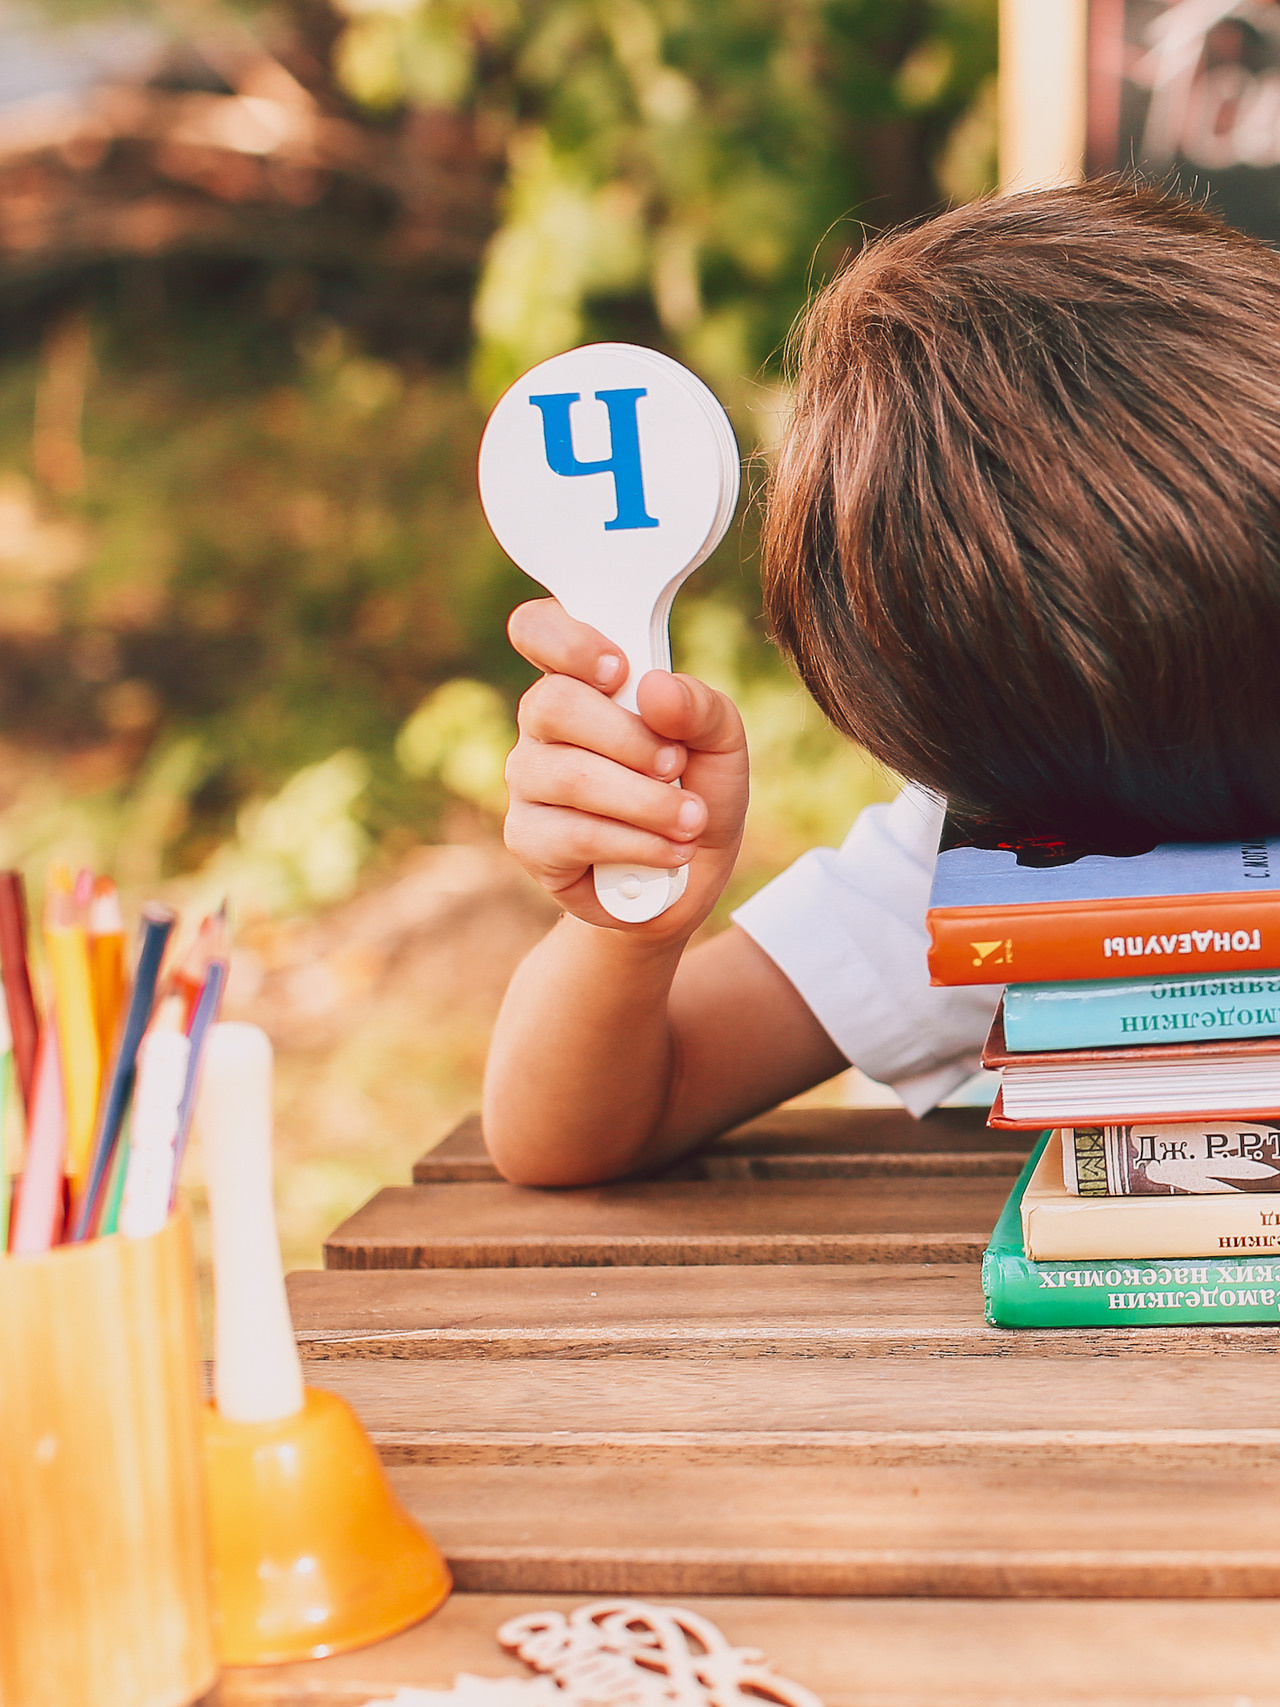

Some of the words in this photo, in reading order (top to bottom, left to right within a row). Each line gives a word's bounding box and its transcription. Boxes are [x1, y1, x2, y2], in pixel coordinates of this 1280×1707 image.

[528, 387, 659, 530] Ч
[1103, 929, 1262, 957] ГОНДЕЛУПЫ
[1133, 1134, 1196, 1170] Дж.
[1039, 1267, 1209, 1289] насекомых
